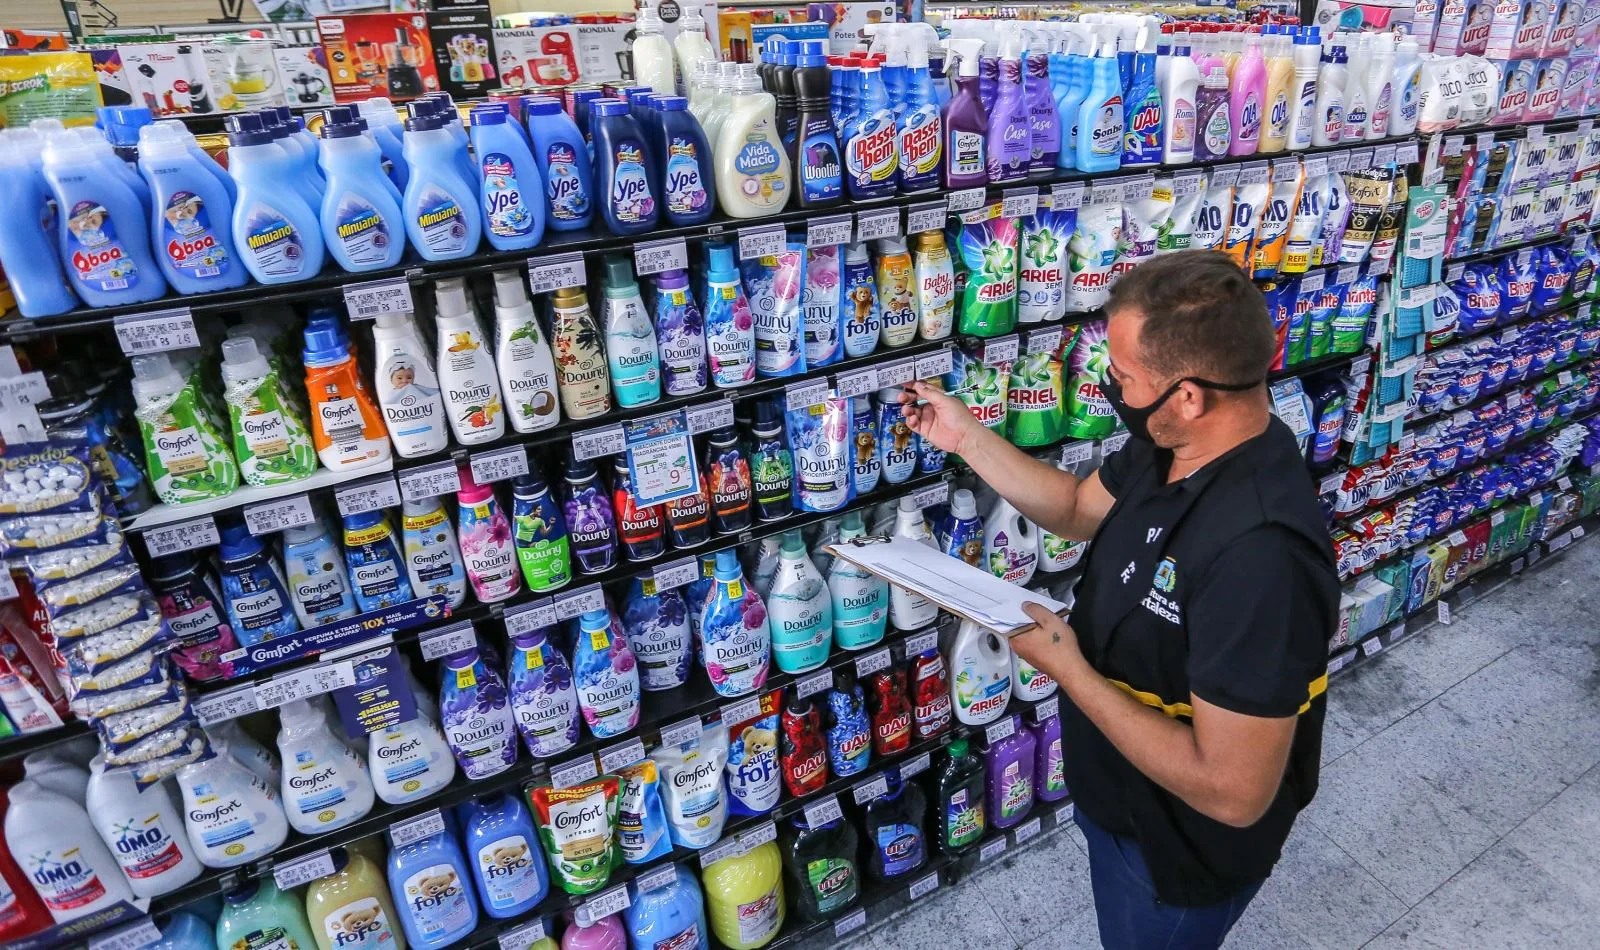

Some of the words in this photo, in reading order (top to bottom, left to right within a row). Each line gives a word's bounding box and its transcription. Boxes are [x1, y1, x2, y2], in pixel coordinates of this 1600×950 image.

[1416, 3, 1436, 13] urca
[1444, 6, 1464, 15] urca
[1496, 4, 1518, 14] urca
[579, 26, 616, 34] MONDIAL
[1463, 24, 1490, 43] urca
[1518, 24, 1543, 43] urca
[1551, 24, 1576, 43] urca
[1501, 90, 1526, 109] urca
[1532, 89, 1558, 107] urca
[1031, 106, 1053, 116] Downy
[1133, 107, 1162, 131] UAU
[1010, 116, 1027, 125] Downy
[1325, 122, 1342, 132] urca
[1004, 125, 1028, 141] Casa
[1092, 123, 1123, 140] Sonho
[747, 145, 770, 156] Vida
[957, 138, 981, 150] Comfort
[1558, 143, 1577, 161] OMO
[740, 152, 775, 169] Macia
[1527, 150, 1546, 167] OMO
[805, 162, 840, 180] Woolite
[550, 177, 579, 200] Ypê
[617, 176, 646, 202] Ypê
[669, 170, 698, 194] Ypê
[488, 190, 519, 215] Ypê
[1544, 196, 1561, 213] OMO
[1575, 189, 1593, 206] OMO
[418, 205, 458, 228] Minuano
[1511, 204, 1530, 221] OMO
[338, 215, 380, 239] Minuano
[248, 226, 292, 250] Minuano
[168, 236, 215, 261] Qboa
[72, 247, 122, 272] Qboa
[1287, 254, 1308, 264] REFIL
[924, 273, 949, 291] Baby
[1020, 268, 1062, 282] ARIEL
[1072, 272, 1109, 286] ARIE
[934, 280, 952, 299] Soft
[979, 278, 1016, 297] ARIEL
[846, 319, 880, 337] fofo
[882, 310, 916, 329] fofo
[664, 346, 701, 361] Downy
[713, 339, 751, 354] Downy
[619, 352, 653, 366] Downy
[510, 375, 549, 391] Downy
[566, 365, 607, 383] Downy
[450, 386, 490, 403] Downy
[1008, 388, 1058, 404] ARIEL
[322, 404, 357, 422] Comfort
[387, 403, 434, 421] Downy
[969, 403, 1006, 422] RIEL
[1026, 402, 1058, 410] RADIANTES
[244, 417, 282, 436] Comfort
[158, 434, 198, 452] Comfort
[800, 454, 846, 475] Downy
[886, 450, 916, 467] fofo
[756, 478, 790, 493] Downy
[715, 489, 750, 505] Downy
[672, 502, 707, 518] Downy
[622, 516, 660, 532] Downy
[572, 528, 610, 544] Downy
[413, 550, 449, 566] Comfort
[472, 552, 512, 572] Downy
[522, 544, 562, 562] Downy
[1056, 549, 1079, 562] ARIEL
[357, 565, 393, 581] Comfort
[1004, 568, 1028, 582] ARIEL
[299, 579, 338, 598] Comfort
[236, 595, 276, 614] Comfort
[844, 590, 881, 608] Downy
[1148, 588, 1168, 606] itura
[1169, 601, 1180, 612] de
[386, 612, 402, 620] MAIS
[1140, 596, 1180, 625] rtaleza
[171, 612, 213, 632] Comfort
[362, 618, 385, 631] 10X
[784, 612, 823, 631] Downy
[304, 630, 335, 644] PERFUMA
[340, 624, 360, 634] TRATA
[316, 635, 334, 644] SUAS
[252, 639, 302, 662] Comfort
[634, 636, 682, 654] Downy
[717, 638, 763, 660] Downy
[586, 682, 633, 704] Downy
[522, 702, 570, 723] Downy
[916, 696, 950, 718] urca
[970, 696, 1005, 712] ARIEL
[454, 720, 504, 744] Downy
[879, 714, 910, 737] UAU
[378, 738, 422, 759] Comfort
[841, 730, 871, 754] UAU
[388, 754, 418, 766] INTENSE
[748, 748, 777, 768] super
[794, 751, 826, 778] UAU
[289, 768, 337, 790] Comfort
[674, 760, 716, 787] Comfort
[301, 784, 333, 796] INTENSE
[622, 782, 641, 798] fort
[684, 783, 712, 797] INTENSE
[1006, 794, 1030, 808] ARIEL
[190, 800, 242, 822] Comfort
[555, 804, 602, 830] Comfort
[204, 816, 238, 829] INTENSE
[952, 821, 979, 838] ARIEL
[115, 828, 162, 854] OMO
[566, 828, 596, 839] INTENSE
[574, 848, 592, 856] DETOX
[887, 834, 917, 857] urca
[34, 860, 82, 886] OMO
[818, 866, 850, 892] urca
